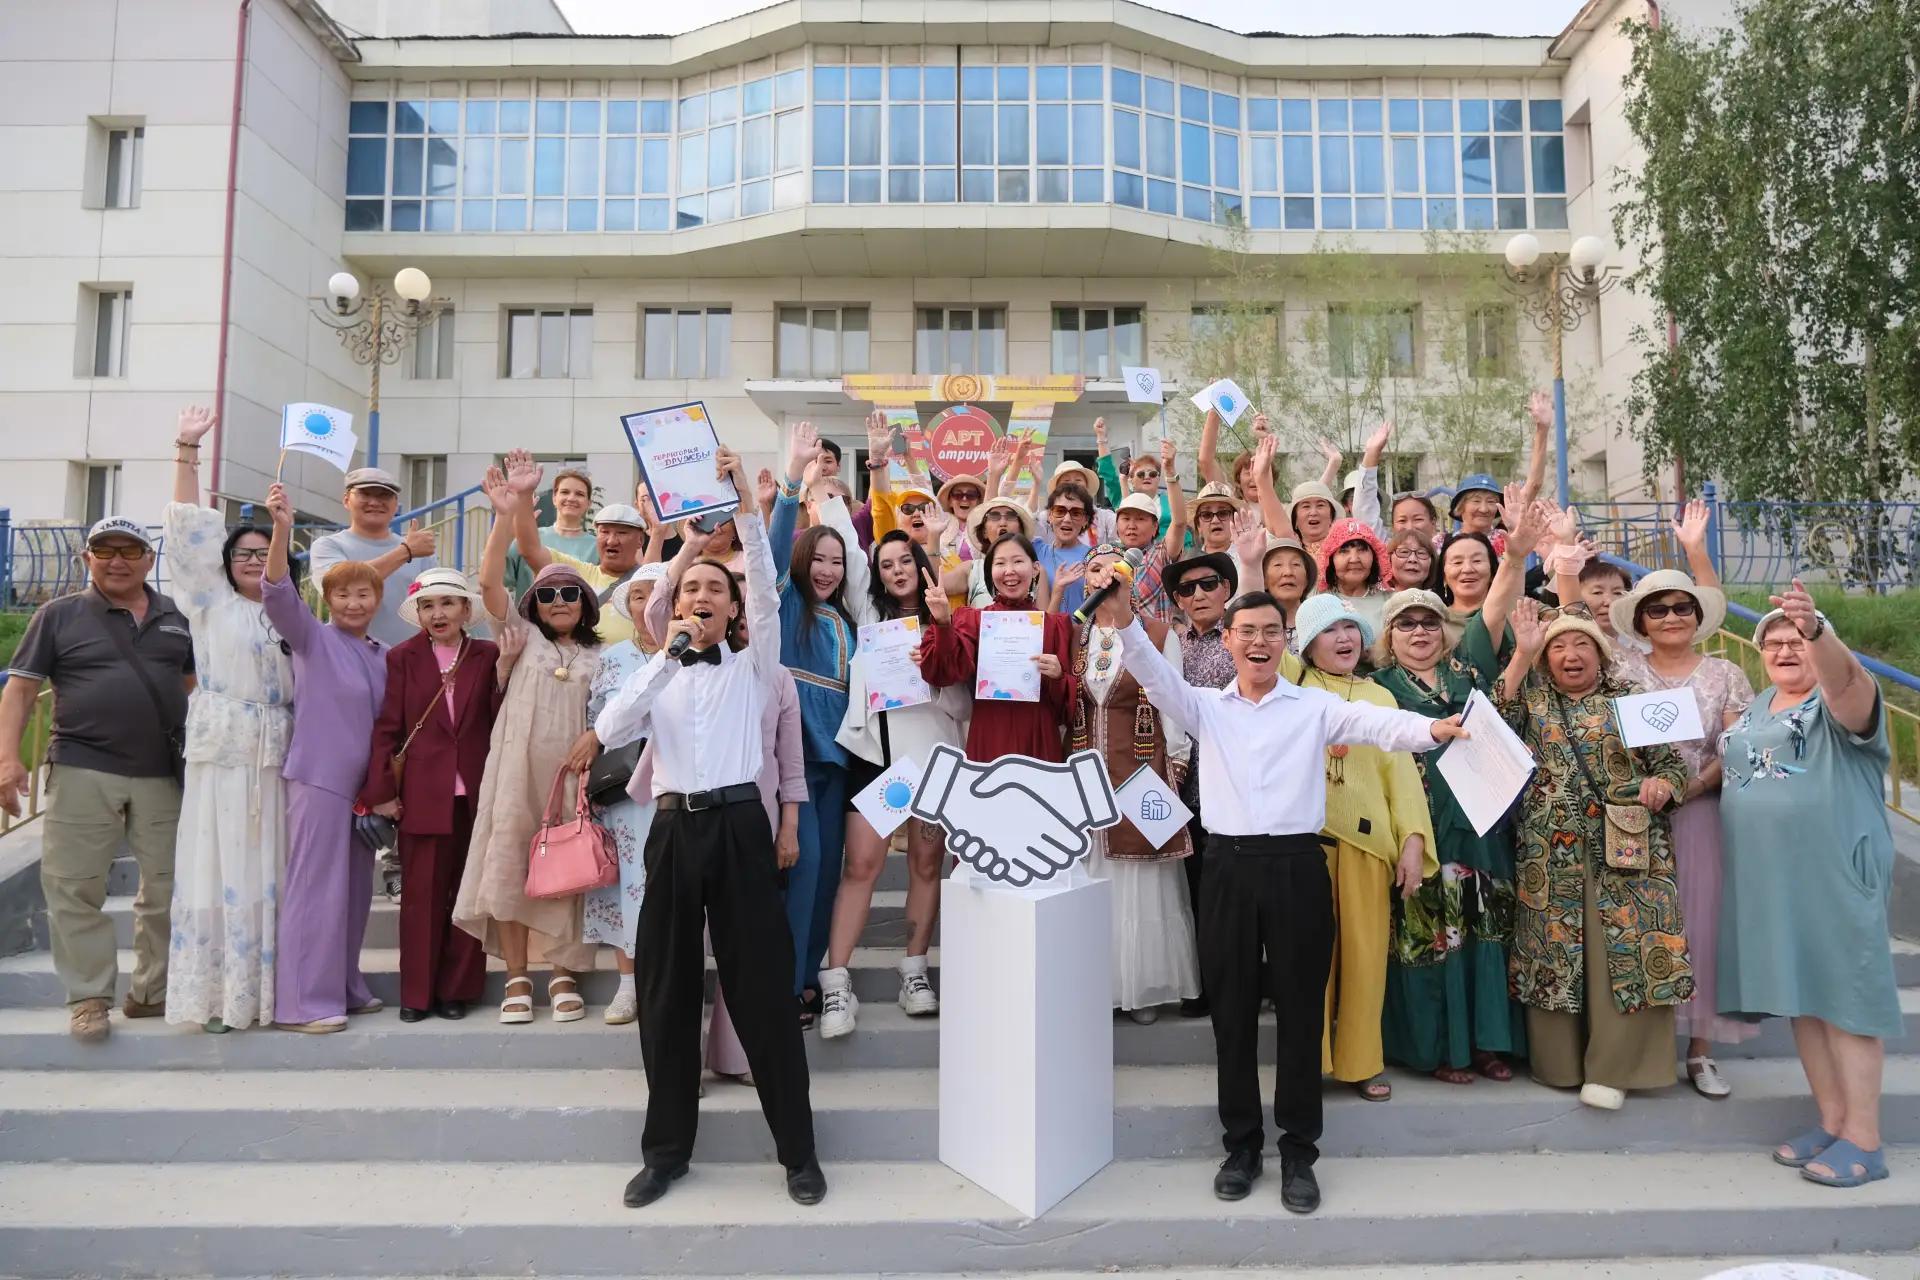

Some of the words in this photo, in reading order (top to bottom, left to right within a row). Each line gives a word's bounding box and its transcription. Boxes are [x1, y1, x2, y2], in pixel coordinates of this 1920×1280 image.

[942, 429, 984, 446] АРТ
[653, 446, 699, 461] ТЕРРИТОРИЯ
[664, 450, 711, 466] ДРУЖБЫ
[938, 449, 991, 463] атриум
[99, 519, 141, 534] YAKUTIA
